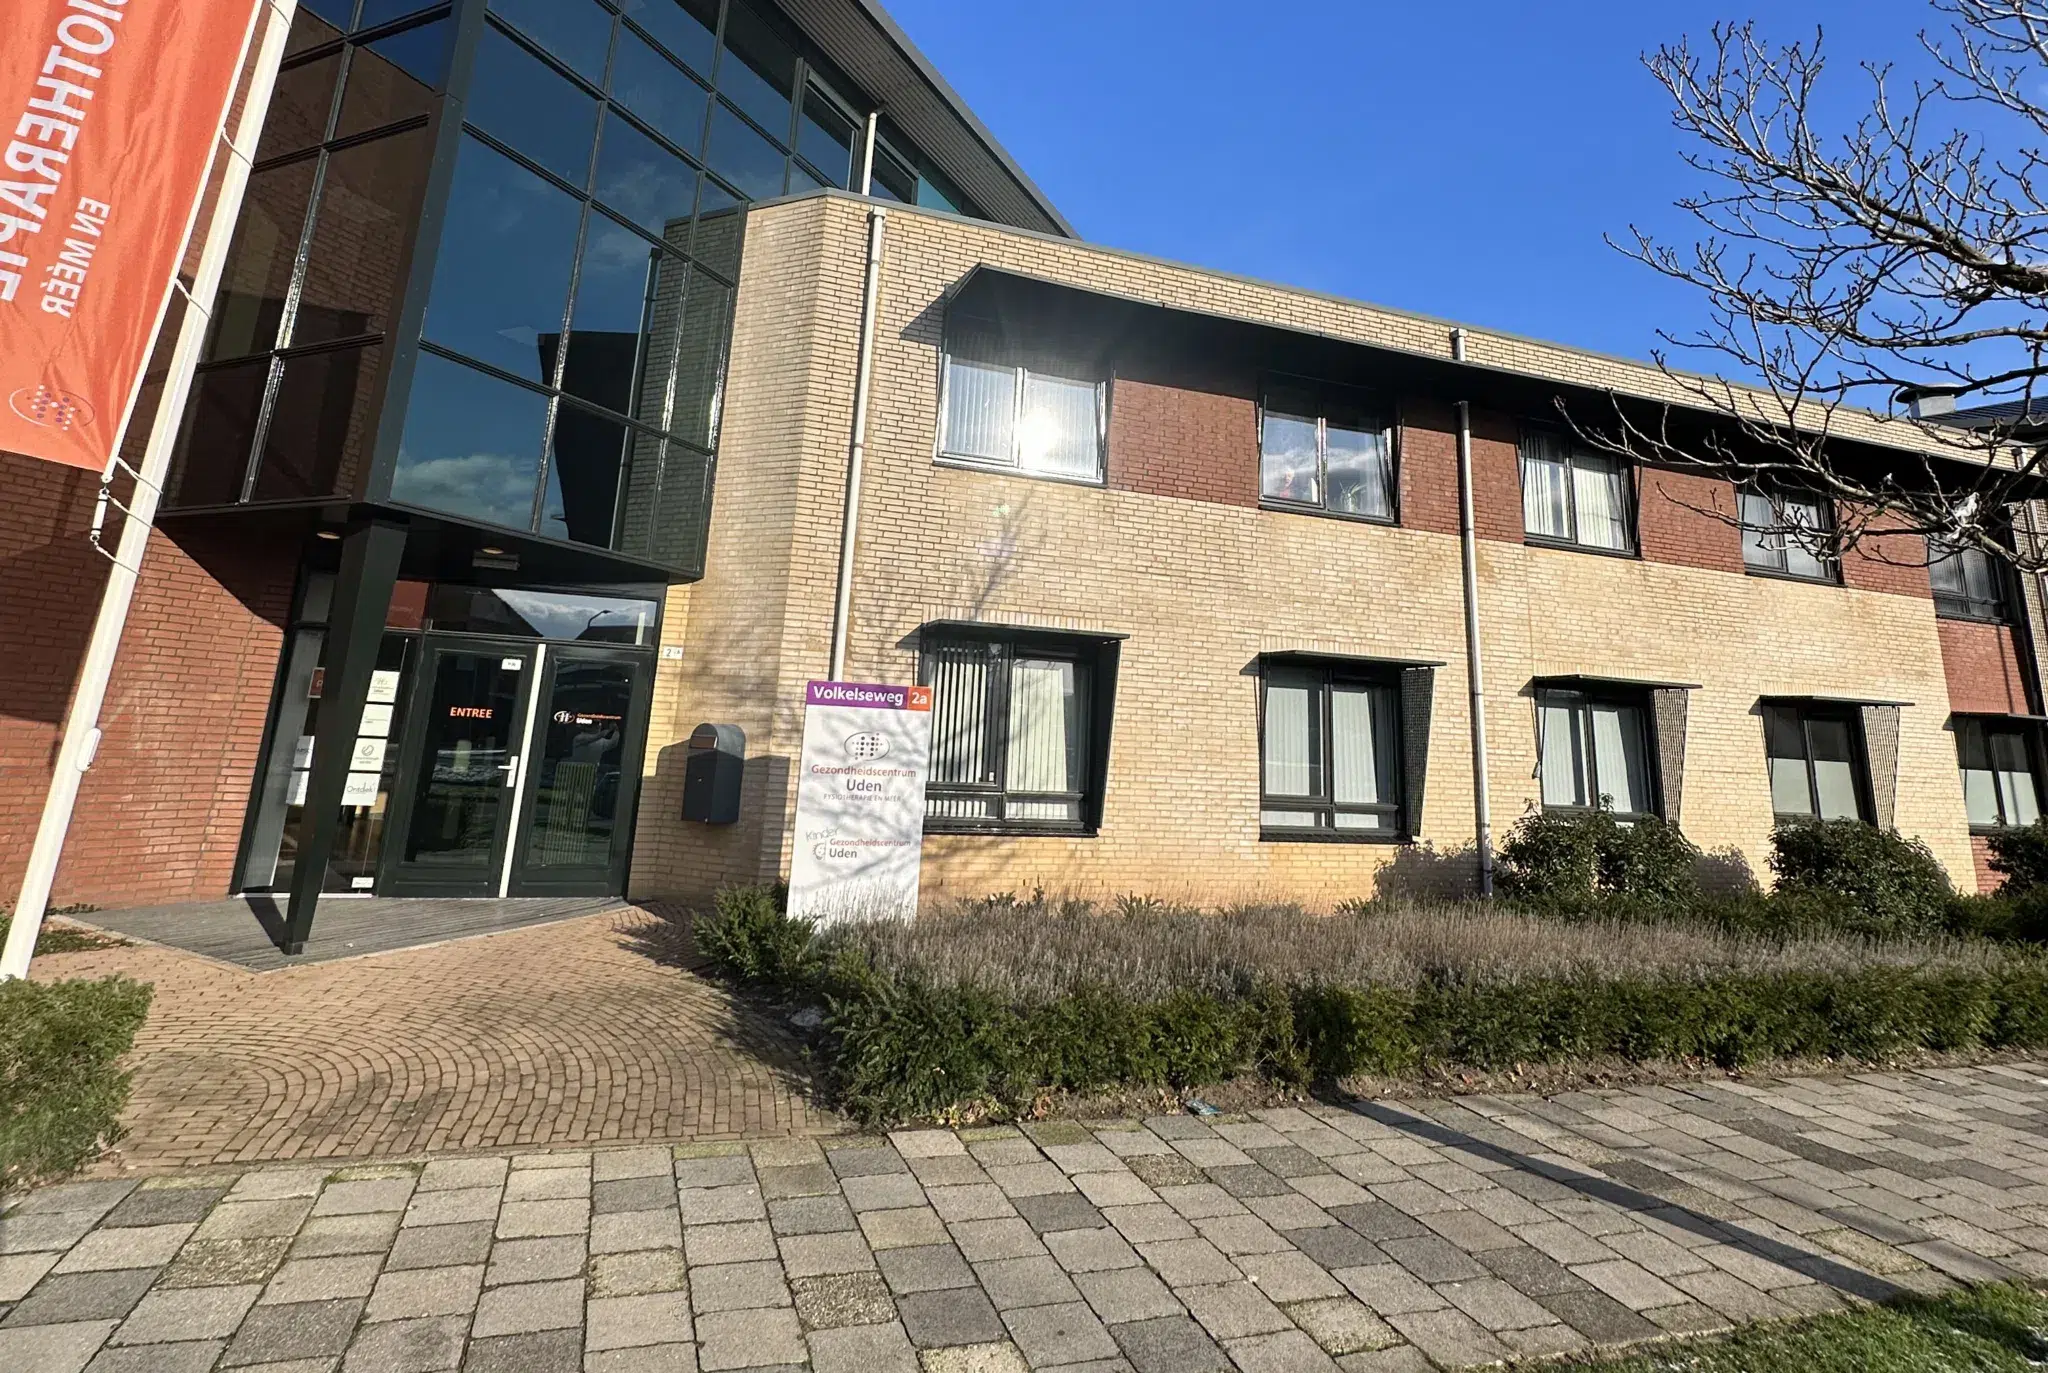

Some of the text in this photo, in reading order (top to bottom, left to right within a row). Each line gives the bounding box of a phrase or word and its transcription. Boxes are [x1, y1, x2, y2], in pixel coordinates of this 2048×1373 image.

[813, 685, 928, 707] Volkelseweg 2a
[450, 706, 493, 719] ENTREE
[811, 764, 917, 778] Gezondheidscentrum
[846, 778, 882, 792] Uden
[805, 827, 840, 842] Kinder
[829, 838, 912, 848] Gezondheidscentrum
[829, 848, 858, 859] Uden
